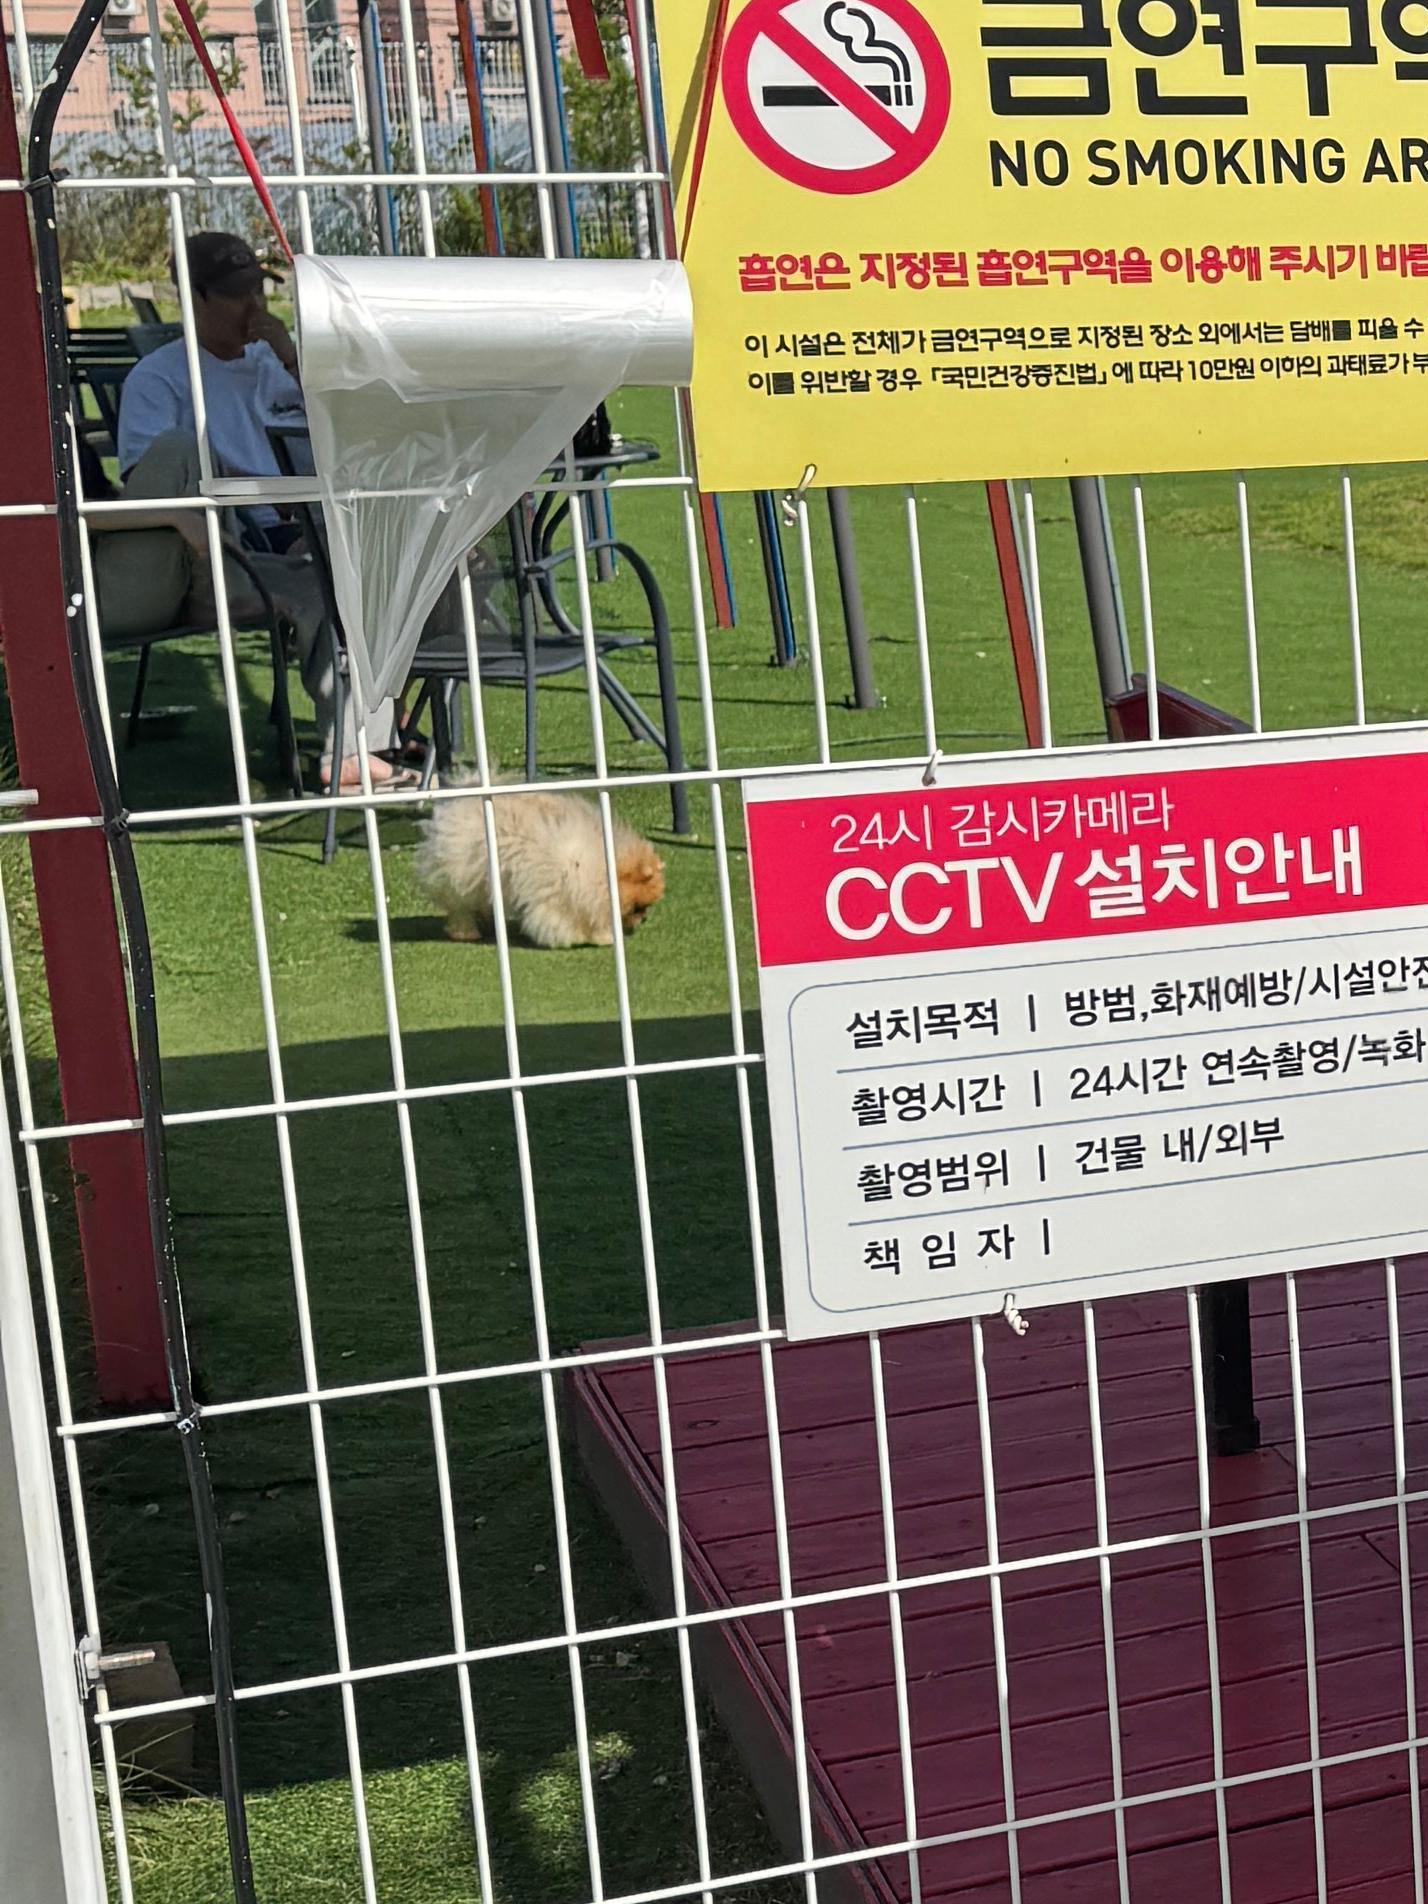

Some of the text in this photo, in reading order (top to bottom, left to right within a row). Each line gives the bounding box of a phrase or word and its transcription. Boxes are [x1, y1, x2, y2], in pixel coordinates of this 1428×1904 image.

[991, 139, 1070, 188] NO
[1087, 136, 1345, 186] SMOKING
[738, 252, 851, 293] 흡연은
[859, 251, 970, 290] 지정된
[977, 247, 1152, 287] 흡연구역을
[1160, 245, 1262, 284] 이용해
[1270, 245, 1369, 281] 주시기
[745, 335, 768, 358] 이
[775, 331, 846, 357] 시설은
[851, 329, 927, 355] 전체가
[931, 326, 1072, 352] 금연구역으로
[1077, 325, 1144, 349] 지정된
[1150, 324, 1193, 348] 장소
[1198, 322, 1284, 345] 외에서는
[1289, 319, 1352, 343] 담배를
[1357, 317, 1399, 340] 피울
[1403, 317, 1425, 339] 수
[749, 371, 795, 396] 이를
[800, 369, 870, 394] 위반할
[876, 368, 922, 392] 경우
[1139, 359, 1183, 383] 따라
[1188, 357, 1256, 381] 10만원
[1260, 354, 1321, 378] 이하의
[1327, 352, 1410, 376] 과태료가
[831, 786, 1176, 855] 24시 감시카메라
[823, 825, 1365, 942] CCTV 설치안내
[845, 999, 1000, 1049] 설치목적
[850, 1026, 1428, 1128] 촬영시간 24시간 연속촬영/녹화
[855, 1114, 1286, 1203] 촬영범위 건물 내/외부
